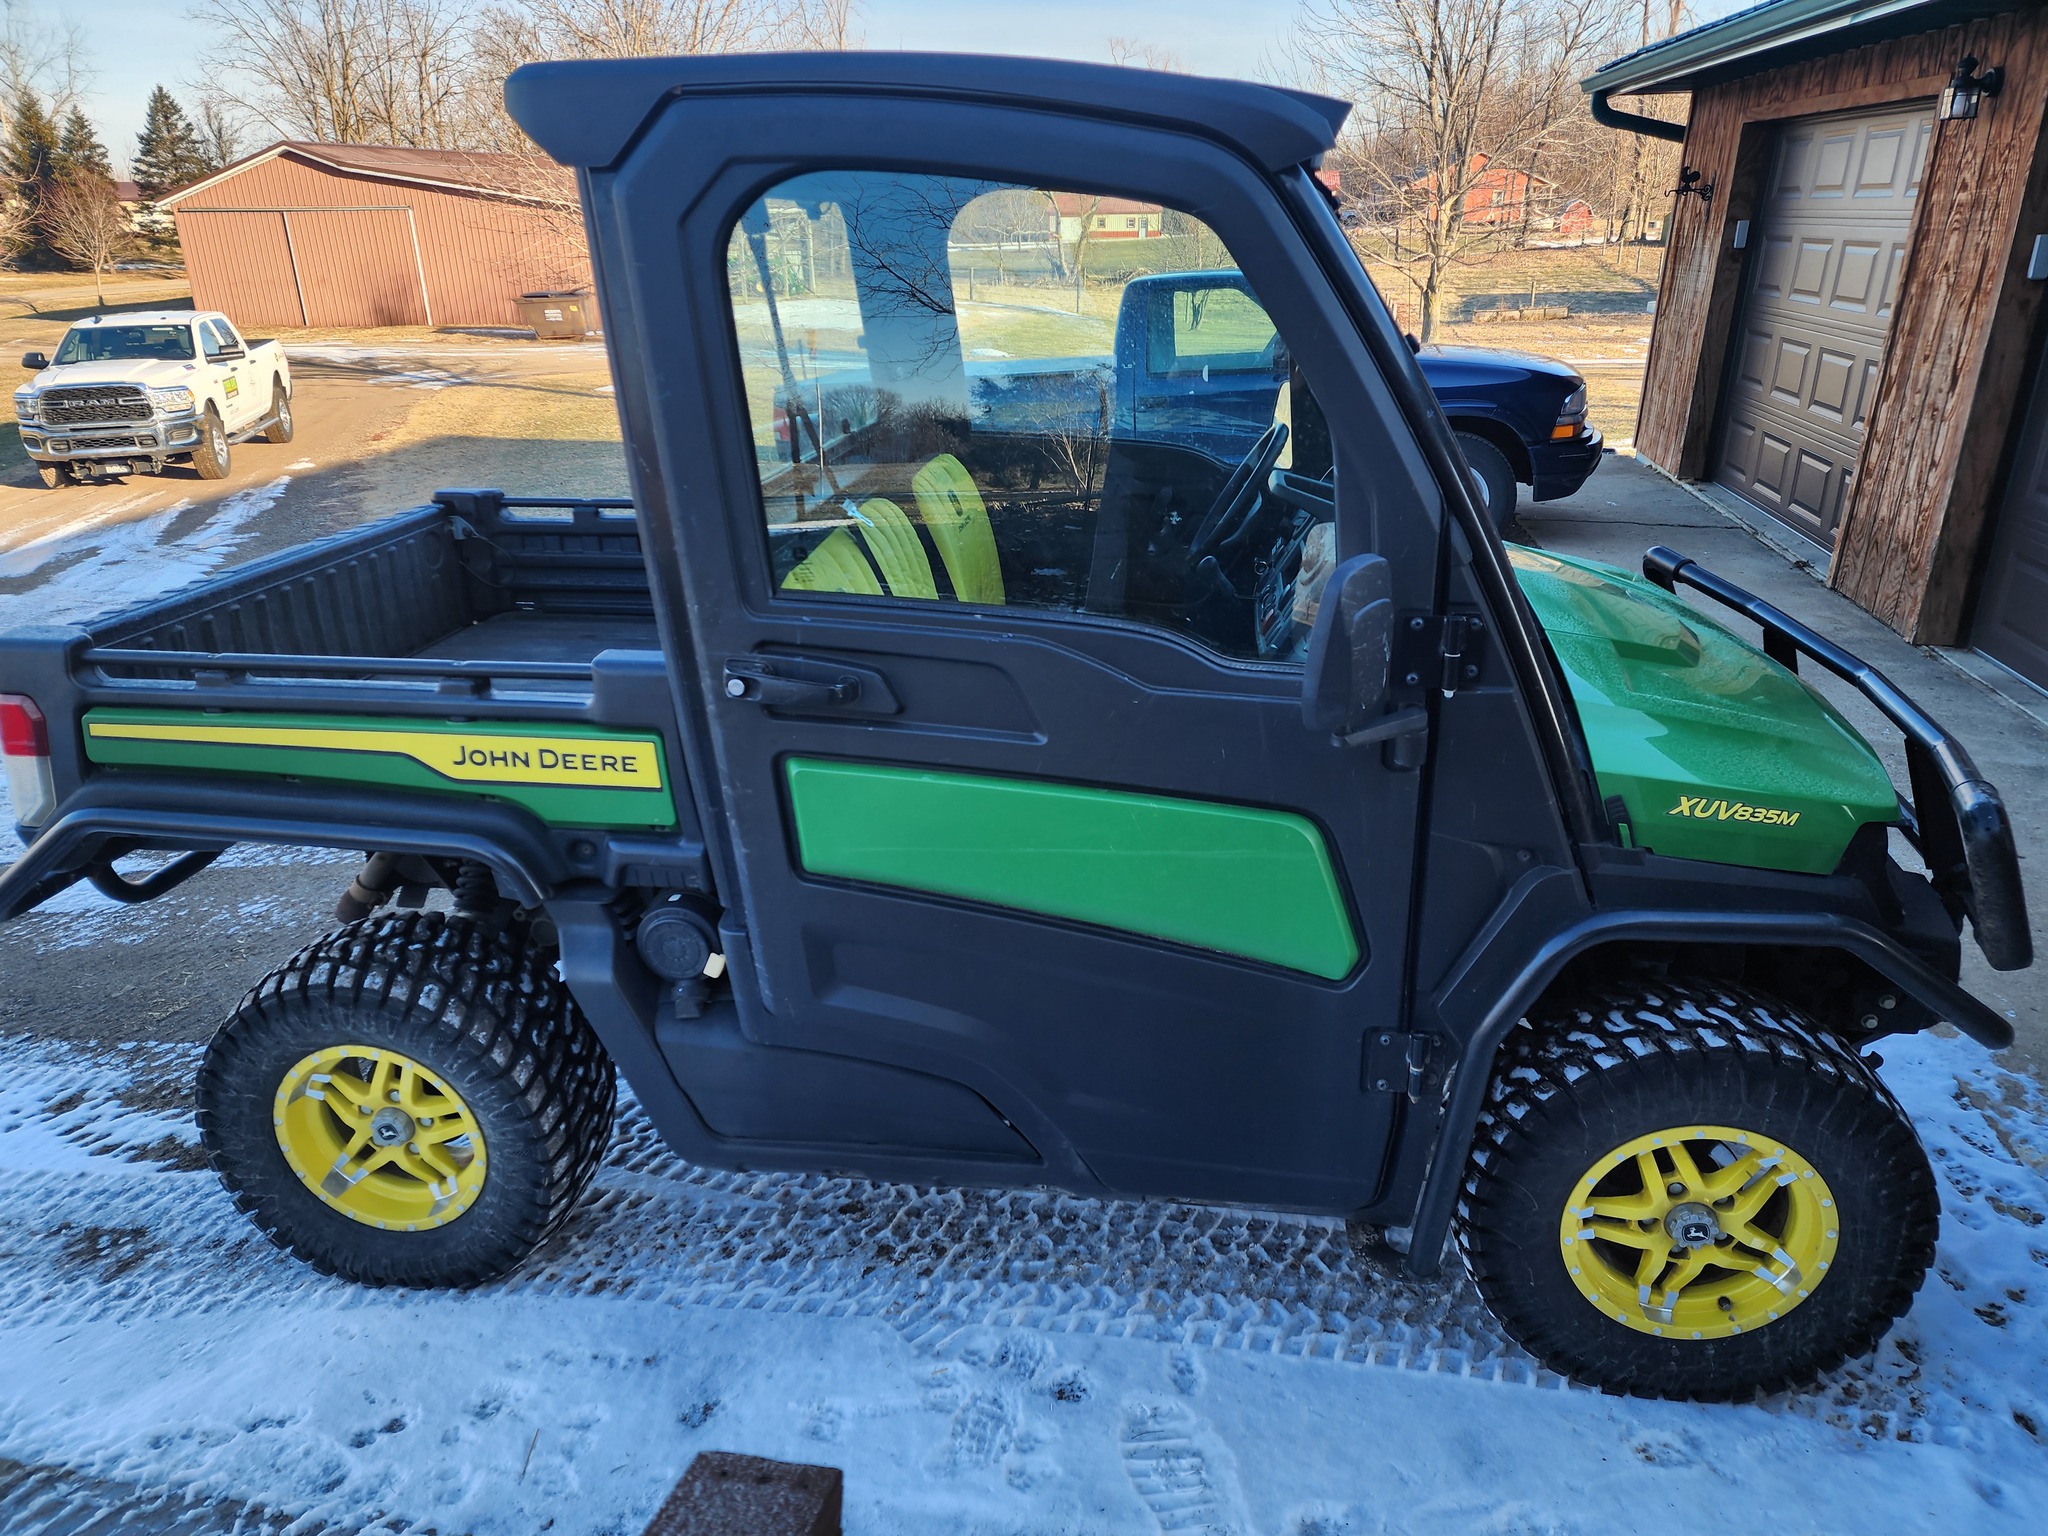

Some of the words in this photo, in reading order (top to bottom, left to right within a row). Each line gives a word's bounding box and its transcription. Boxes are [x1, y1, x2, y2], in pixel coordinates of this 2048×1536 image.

[68, 399, 116, 407] RAM
[453, 745, 530, 768] JOHN
[538, 748, 638, 773] DEERE
[1667, 795, 1801, 827] XUV835M
